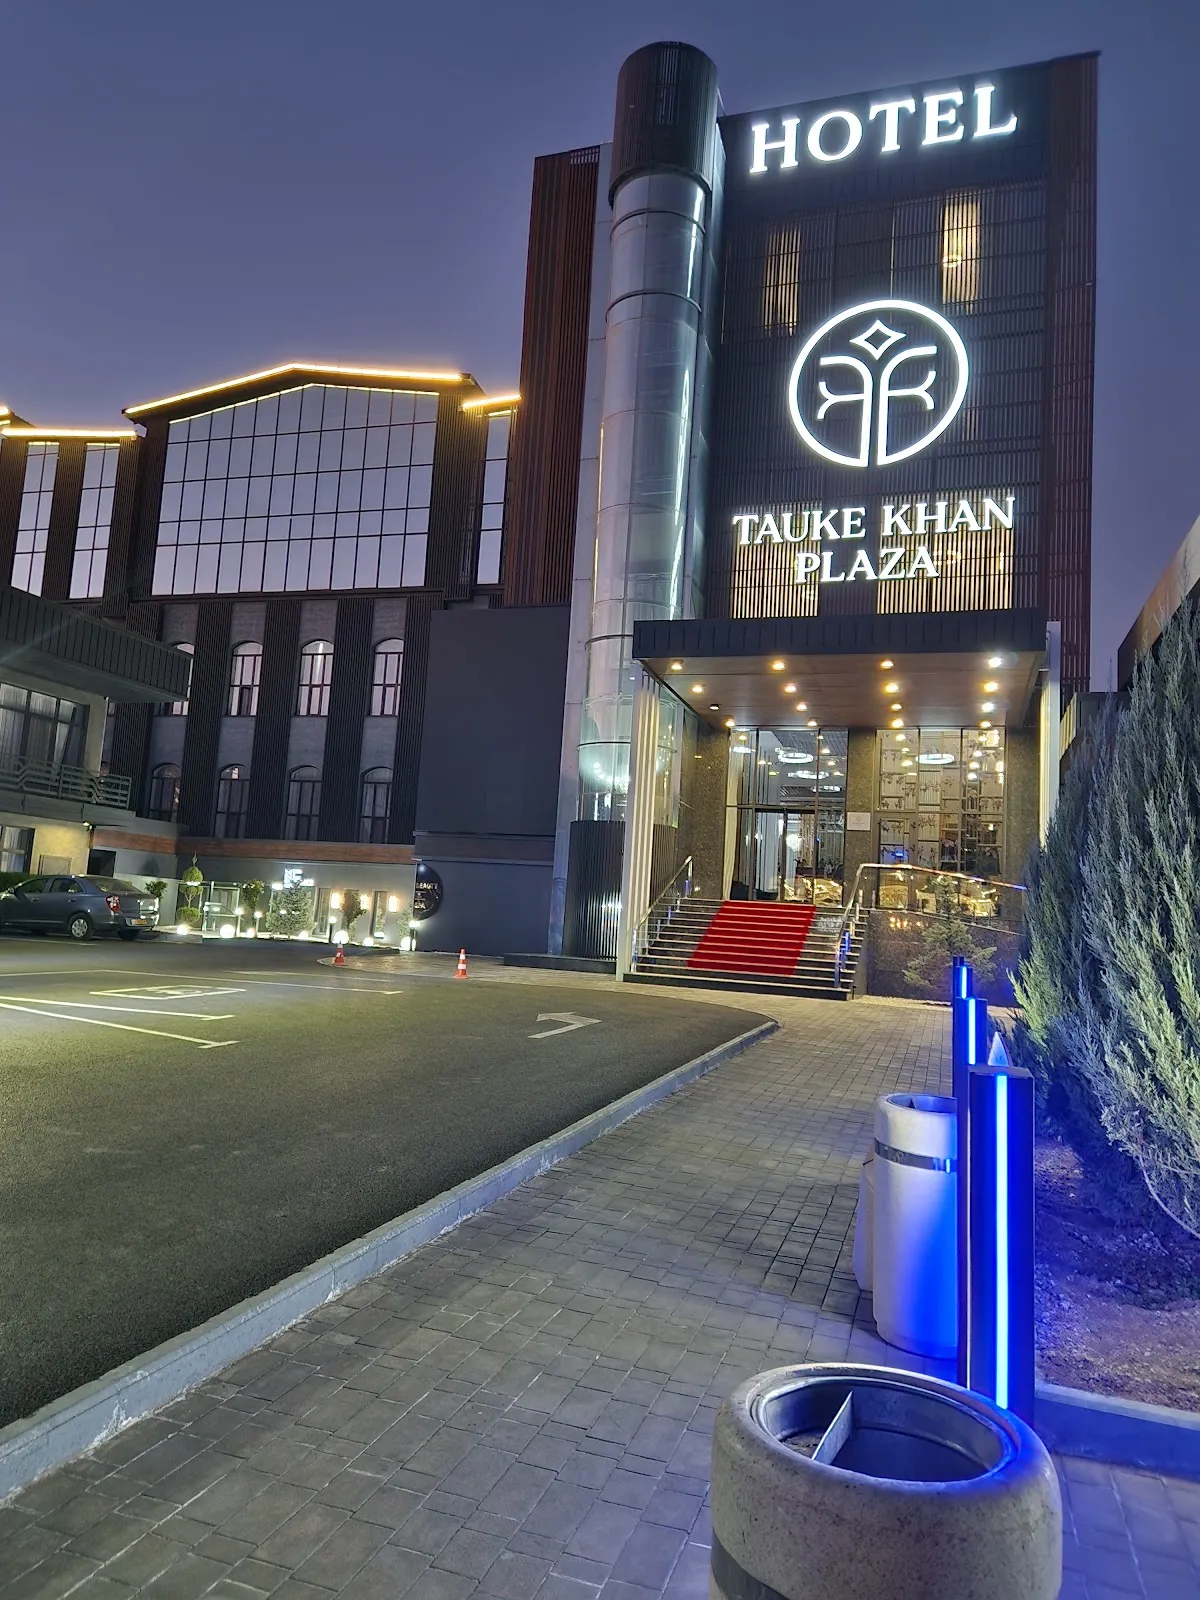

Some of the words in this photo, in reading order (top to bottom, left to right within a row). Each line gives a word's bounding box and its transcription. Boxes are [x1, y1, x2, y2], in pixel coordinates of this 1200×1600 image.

[749, 84, 1018, 174] HOTEL
[732, 507, 866, 546] TAUKE
[881, 496, 1016, 537] KHAN
[794, 546, 940, 584] PLAZA
